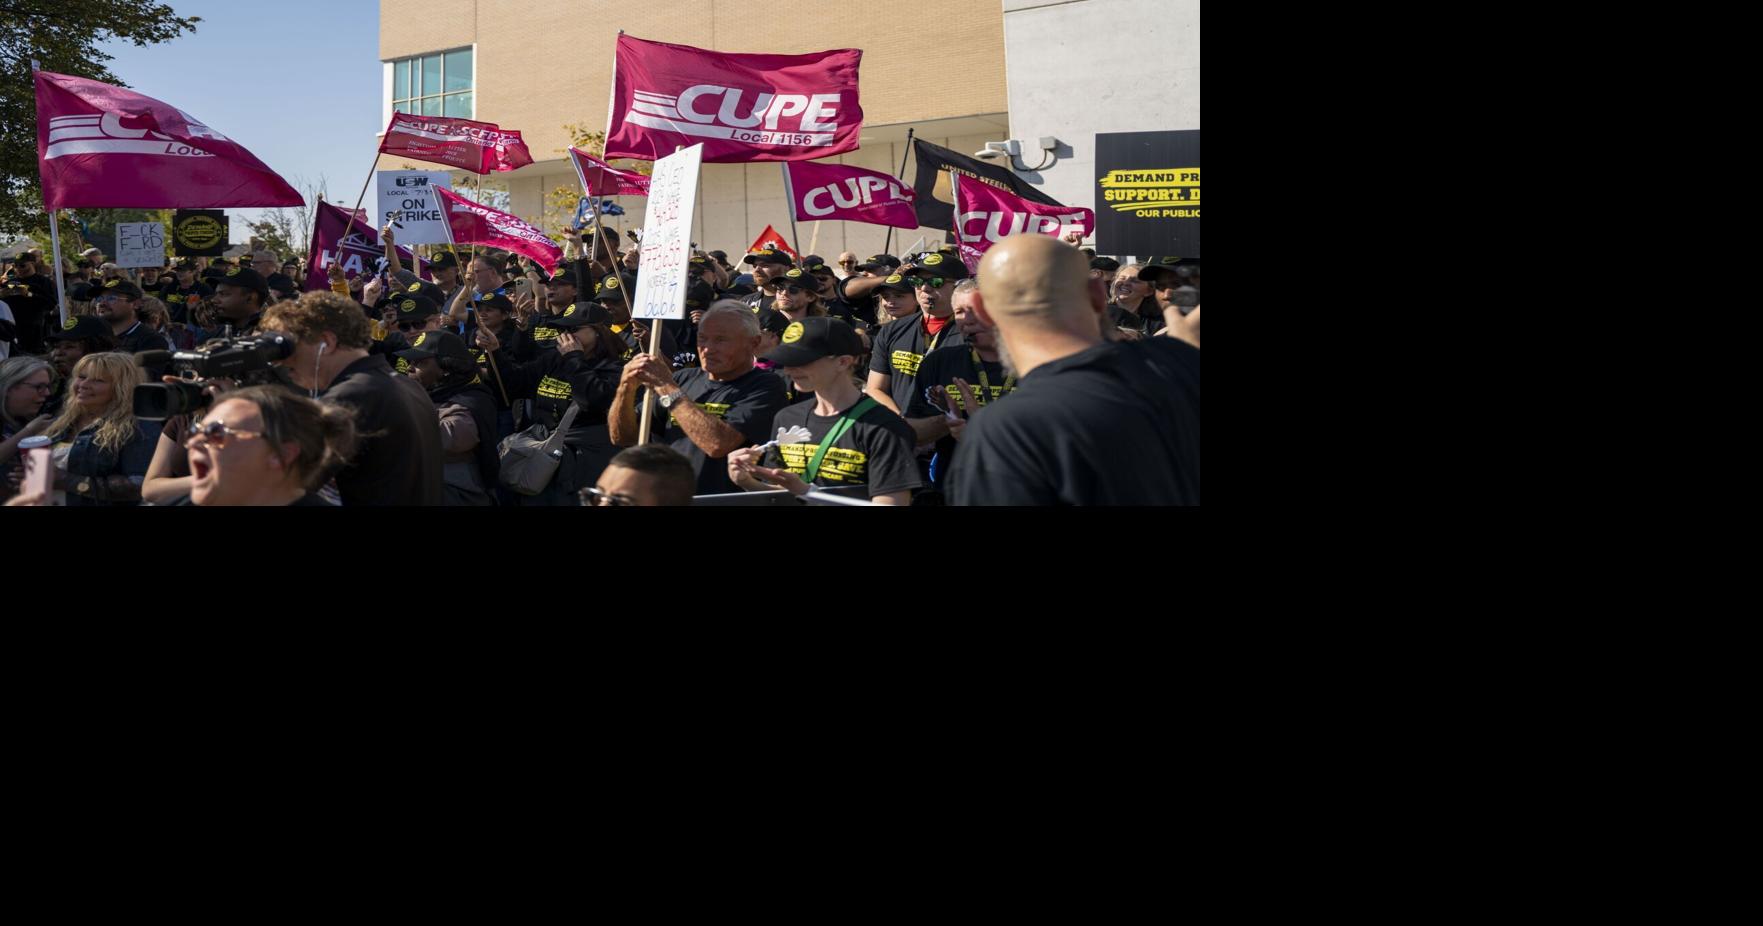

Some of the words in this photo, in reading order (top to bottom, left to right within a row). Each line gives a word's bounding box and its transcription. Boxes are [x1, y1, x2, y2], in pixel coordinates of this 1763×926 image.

[676, 84, 841, 132] CUPE
[410, 121, 449, 135] CUPE
[730, 129, 774, 144] Local
[779, 133, 812, 145] 1156
[396, 177, 429, 187] USW
[1115, 173, 1175, 183] DEMAND
[1104, 188, 1184, 201] SUPPORT.
[402, 198, 425, 210] ON
[1136, 209, 1160, 218] OUR
[120, 223, 160, 238] F_CK
[120, 236, 163, 250] F_RD
